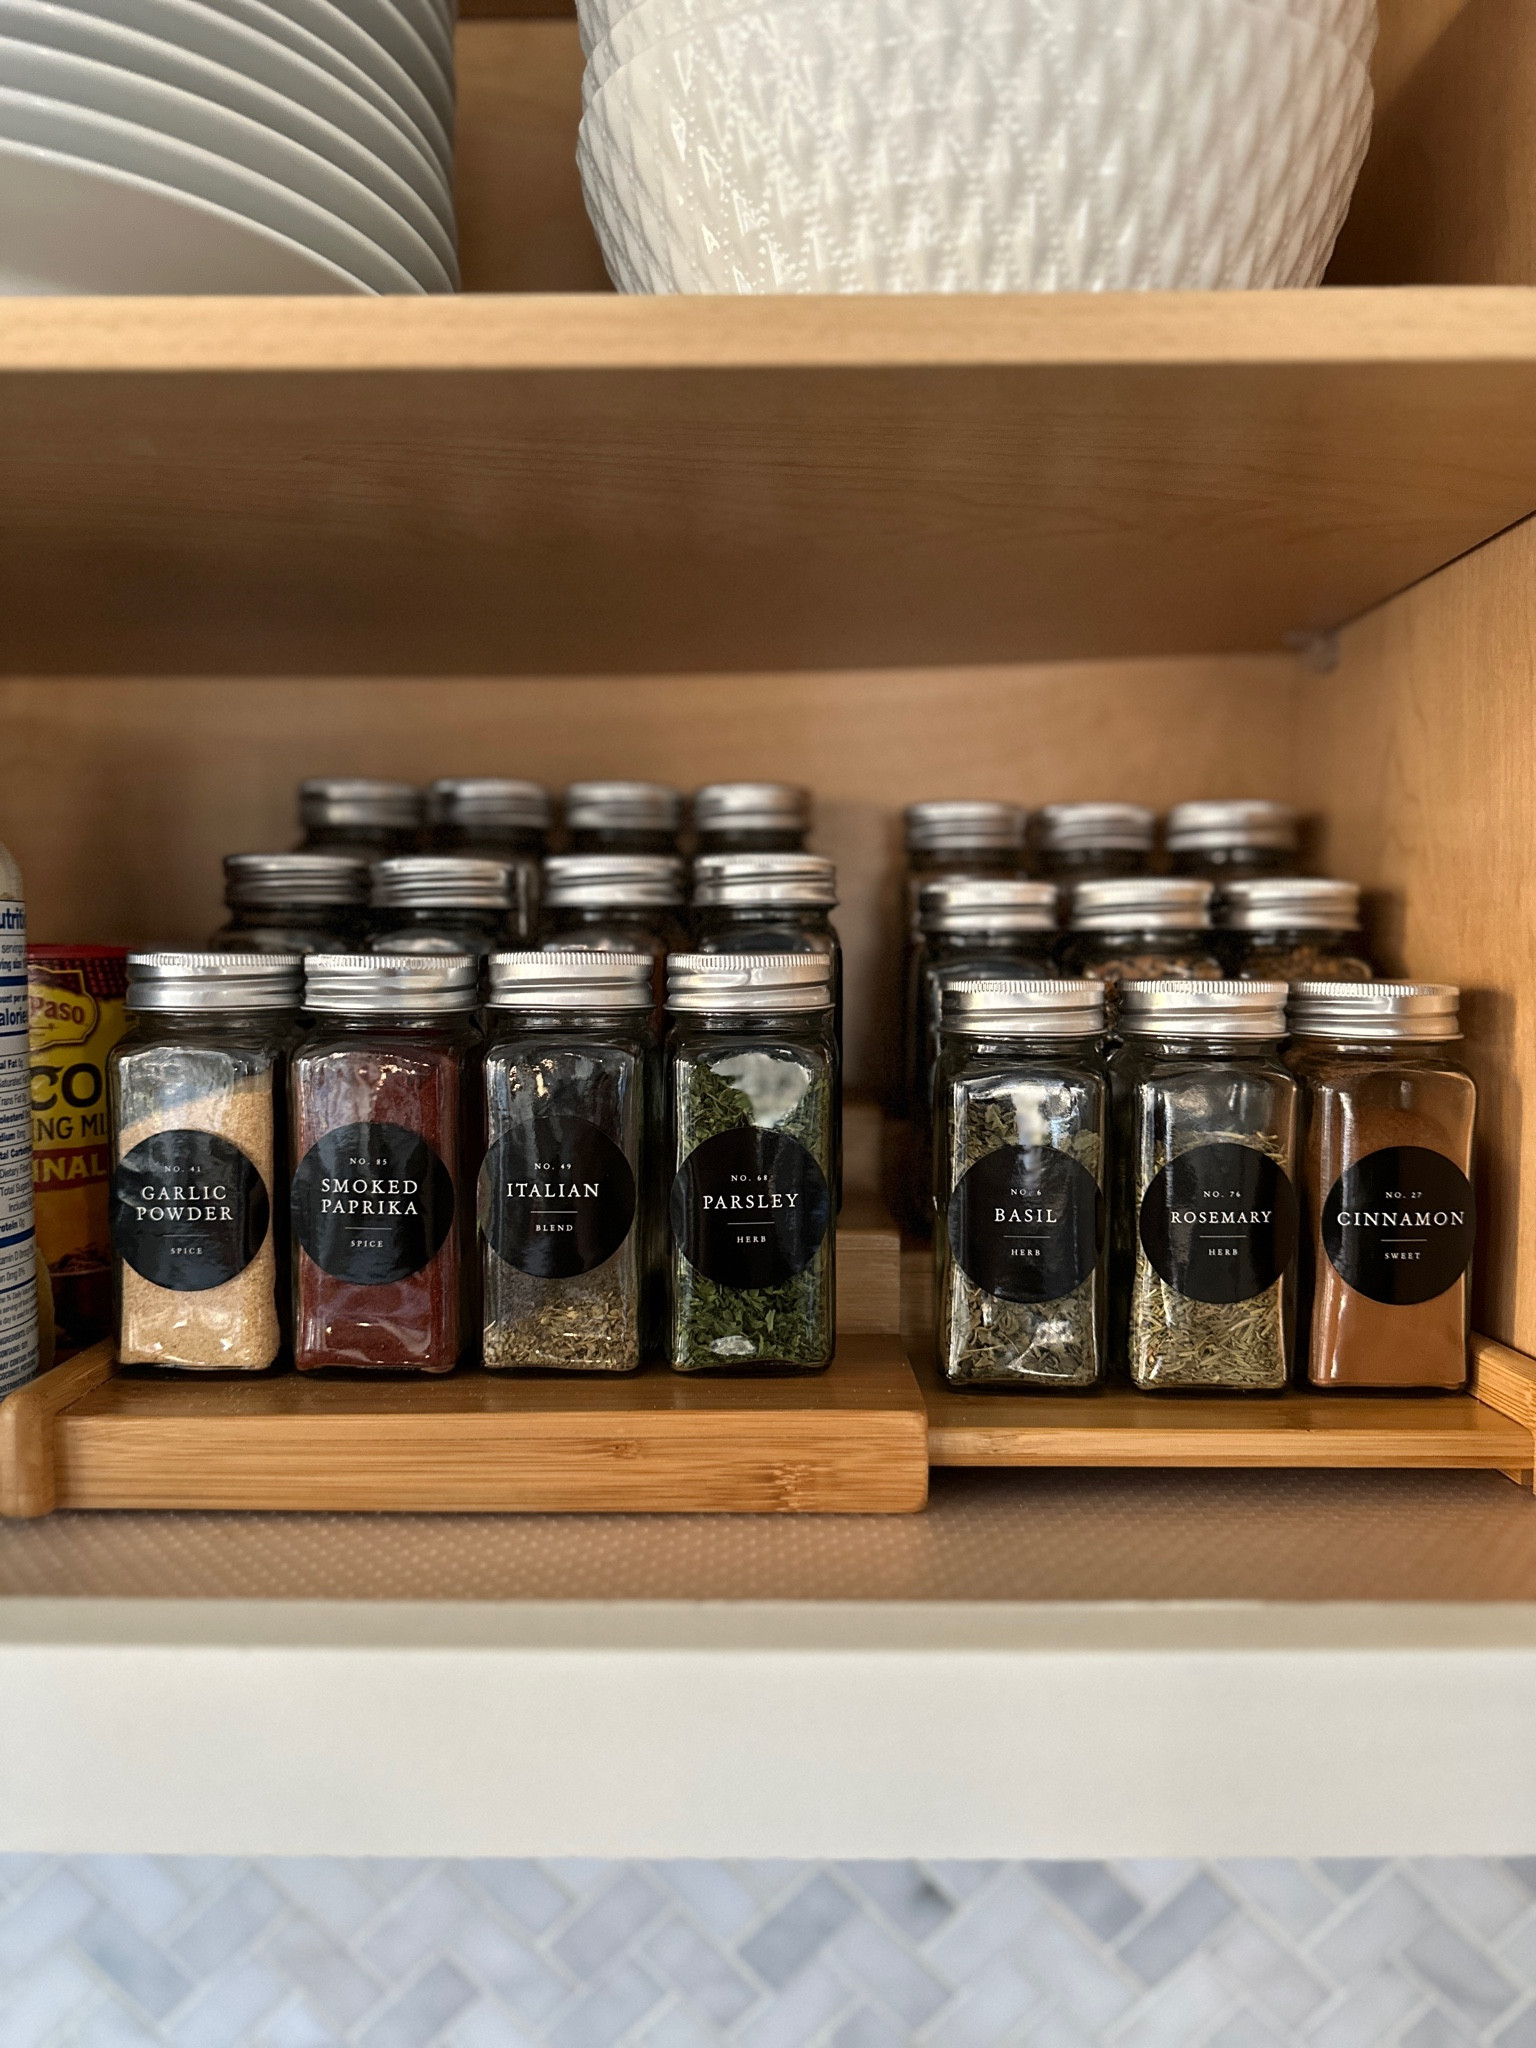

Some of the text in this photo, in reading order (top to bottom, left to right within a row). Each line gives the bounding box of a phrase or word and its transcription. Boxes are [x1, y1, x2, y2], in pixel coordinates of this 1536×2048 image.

[30, 996, 85, 1026] Paso
[350, 1157, 370, 1165] NO.
[165, 1165, 201, 1173] NO. 41
[534, 1162, 572, 1170] NO. 49
[730, 1174, 768, 1182] NO. 68
[321, 1178, 418, 1194] SMOKED
[506, 1182, 600, 1198] ITALIAN
[141, 1185, 227, 1201] GARLIC
[1010, 1188, 1042, 1196] NO. 6
[1203, 1190, 1241, 1198] NO. 76
[1385, 1191, 1423, 1199] NO. 27
[702, 1193, 799, 1210] PARSLEY
[321, 1199, 418, 1215] PAPRIKA
[136, 1206, 234, 1221] POWDER
[994, 1207, 1057, 1223] BASIL
[1170, 1210, 1272, 1224] ROSEMARY
[1336, 1211, 1465, 1227] CINNAMON
[535, 1224, 574, 1232] BLEND
[736, 1235, 767, 1244] HERB
[350, 1240, 384, 1248] SPICE
[170, 1247, 203, 1255] SPICE
[1011, 1248, 1041, 1256] HERB
[1208, 1248, 1239, 1256] HERB
[1384, 1252, 1421, 1260] SWEET
